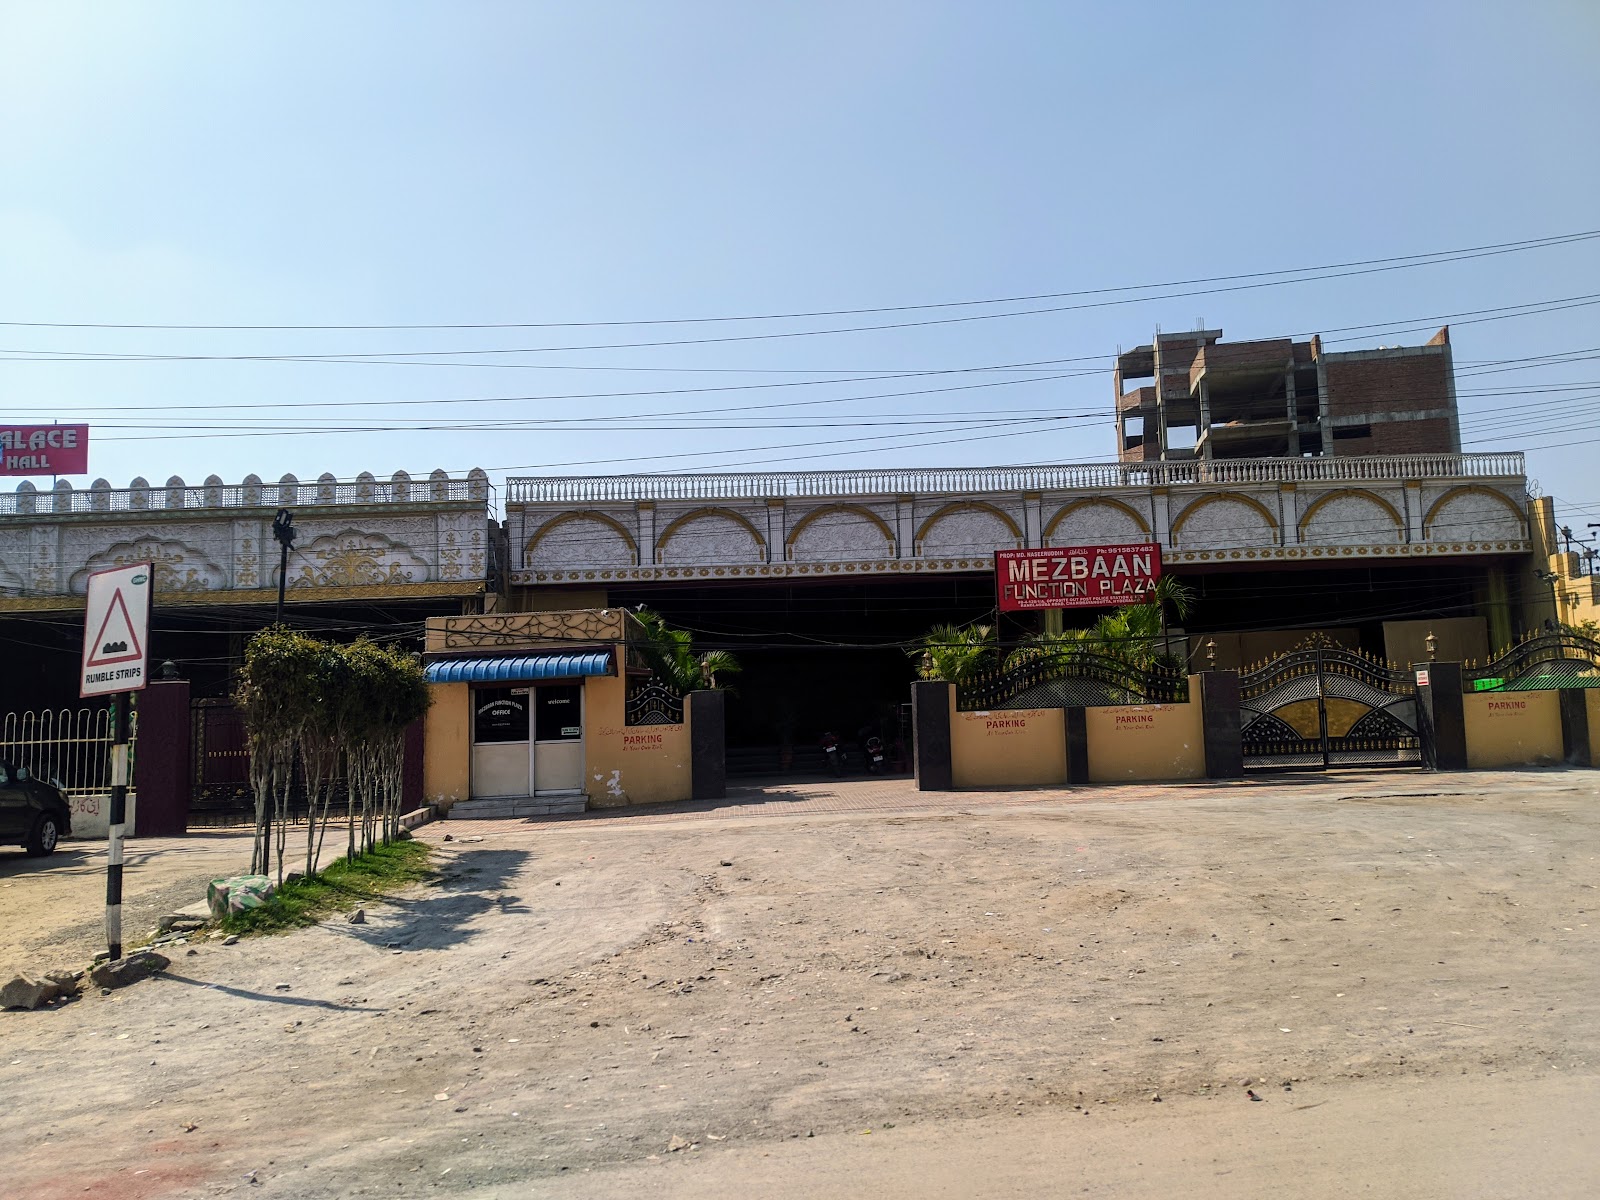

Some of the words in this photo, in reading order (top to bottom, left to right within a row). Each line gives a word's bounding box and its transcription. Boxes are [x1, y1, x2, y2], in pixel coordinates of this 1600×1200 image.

[6, 455, 50, 470] HALL
[1008, 554, 1152, 582] MEZBAAN
[1004, 581, 1088, 600] FUNCTION
[1100, 578, 1157, 596] PLAZA
[85, 670, 114, 684] RUMBLE
[115, 667, 141, 680] STRIPS
[1488, 701, 1526, 710] PARKING
[986, 719, 1026, 729] PARKING
[1115, 715, 1153, 724] PARKING
[623, 734, 662, 745] PARKING
